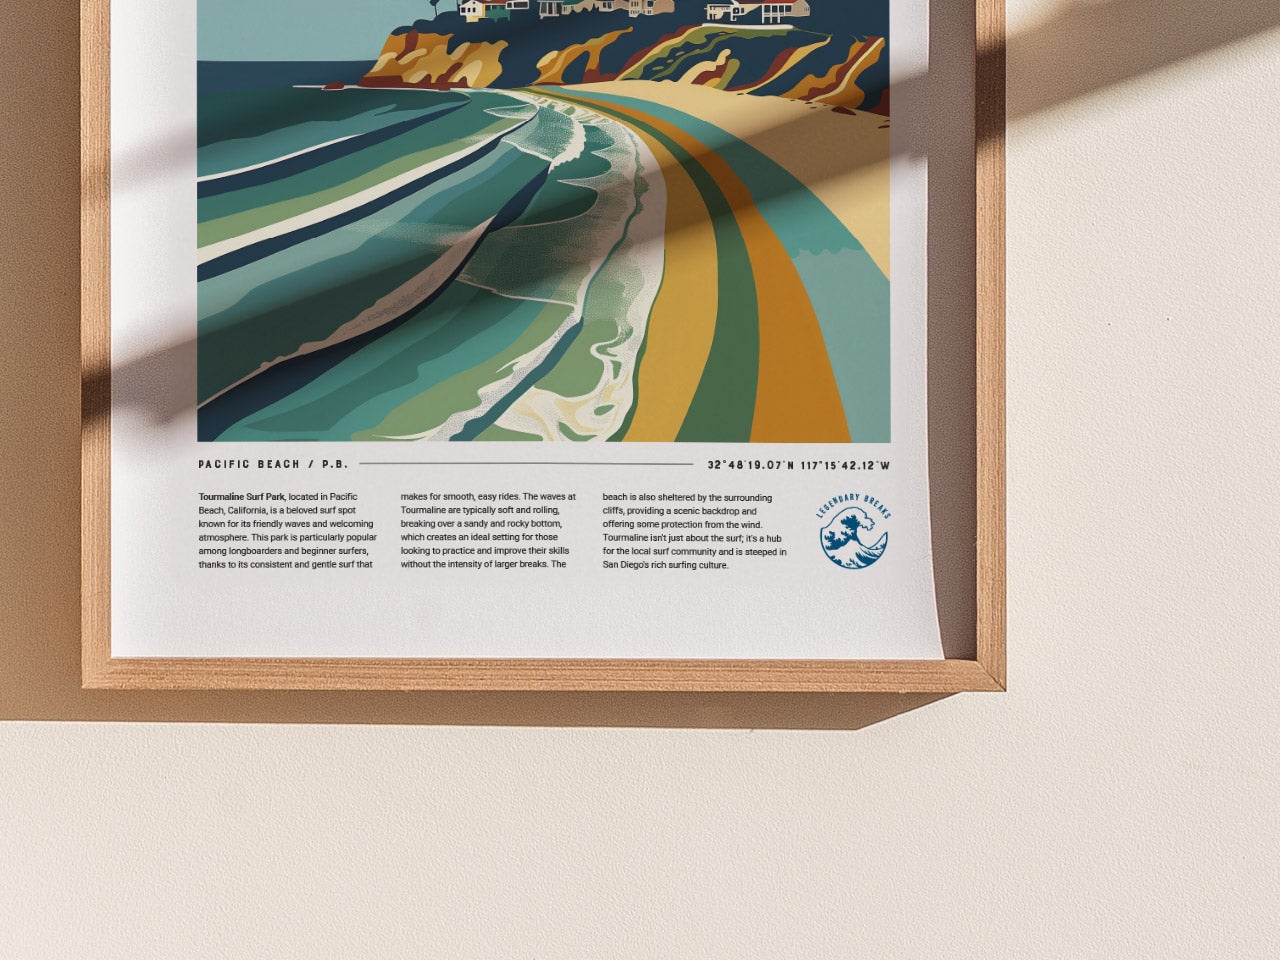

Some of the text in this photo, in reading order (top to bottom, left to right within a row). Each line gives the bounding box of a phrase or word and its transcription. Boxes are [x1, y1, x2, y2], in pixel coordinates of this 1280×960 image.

[199, 460, 249, 468] PACIFIC
[258, 460, 298, 468] BEACH
[323, 460, 347, 468] P.B.
[198, 492, 358, 502] Tourmaline Surf Park, located in Pacific
[400, 492, 428, 501] makes
[429, 492, 441, 501] for
[442, 492, 476, 502] smooth,
[477, 494, 497, 502] easy
[498, 492, 521, 501] rides.
[522, 492, 539, 501] The
[567, 493, 577, 501] at
[602, 493, 773, 504] beach is also sheltered by the surrounding
[198, 506, 356, 516] Beach, California, is beloved surf spot
[400, 505, 447, 514] Tourmaline
[462, 506, 497, 516] typically
[497, 505, 514, 514] soft
[515, 506, 531, 514] and
[532, 506, 560, 516] rolling,
[602, 506, 757, 517] cliffs, providing scenic backdrop and
[816, 493, 891, 519] LEGENDARY BREAKS
[198, 519, 226, 528] known
[227, 519, 240, 528] for
[240, 520, 251, 528] its
[252, 519, 284, 530] friendly
[312, 519, 328, 528] and
[329, 519, 374, 530] welcoming
[400, 519, 436, 529] breaking
[463, 519, 489, 529] sandy
[490, 520, 506, 528] and
[507, 519, 530, 529] rocky
[530, 519, 563, 529] bottom,
[602, 519, 635, 530] offering
[661, 520, 703, 530] protection
[704, 520, 725, 529] from
[725, 521, 740, 529] the
[740, 521, 763, 529] wind.
[198, 533, 378, 543] atmosphere. This park is particularly popular
[400, 533, 425, 541] which
[470, 533, 491, 541] ideal
[492, 533, 520, 543] setting
[521, 532, 534, 541] for
[534, 532, 559, 541] those
[602, 533, 649, 542] Tourmaline
[667, 533, 684, 544] just
[685, 533, 709, 542] about
[710, 534, 725, 542] the
[766, 534, 782, 543] hub
[198, 546, 369, 557] among longboarders and beginner surfers,
[400, 546, 570, 556] looking to practice and improve their skills
[602, 546, 787, 558] for the local surf community and is steeped in
[198, 560, 373, 570] thanks to its consistent and gentle surf that
[400, 559, 567, 570] without the intensity of larger breaks. The
[602, 560, 619, 569] San
[651, 560, 667, 569] rich
[668, 561, 697, 571] surfing
[698, 561, 729, 569] culture.
